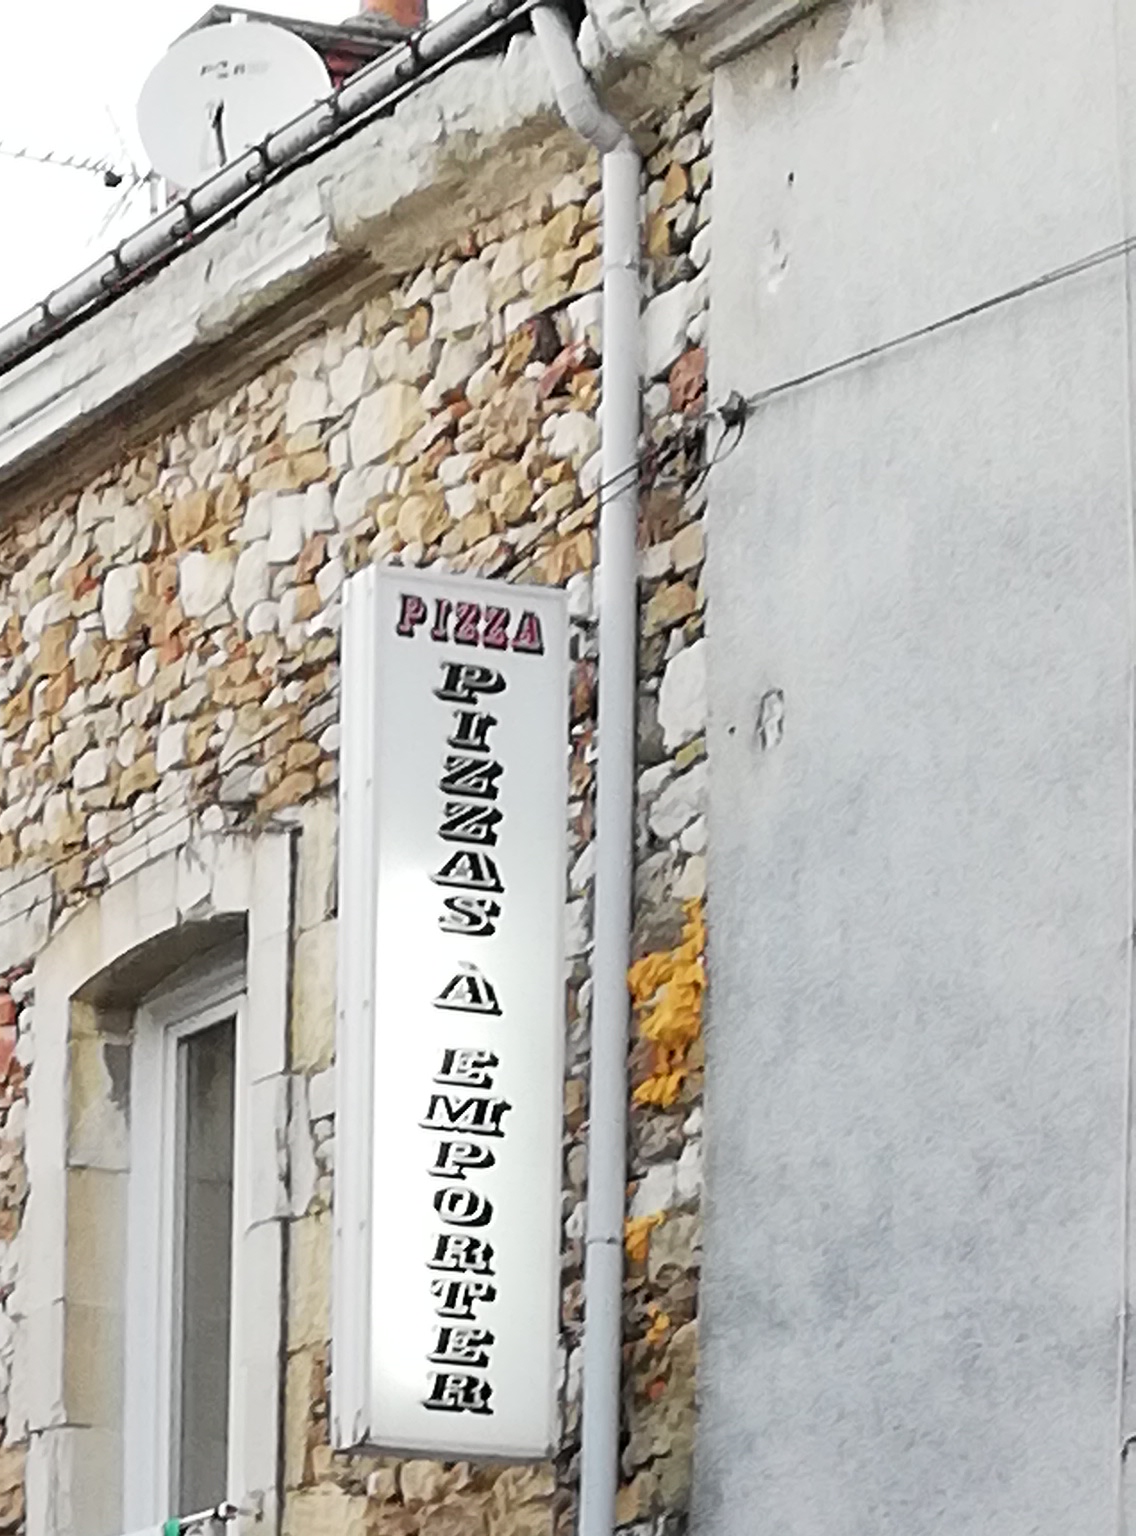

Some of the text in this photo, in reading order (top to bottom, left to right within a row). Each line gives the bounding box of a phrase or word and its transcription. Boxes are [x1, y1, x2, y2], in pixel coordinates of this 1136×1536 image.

[396, 592, 545, 656] PIZZA
[428, 661, 507, 937] PIZZAS
[419, 1046, 512, 1416] EMPORTER
